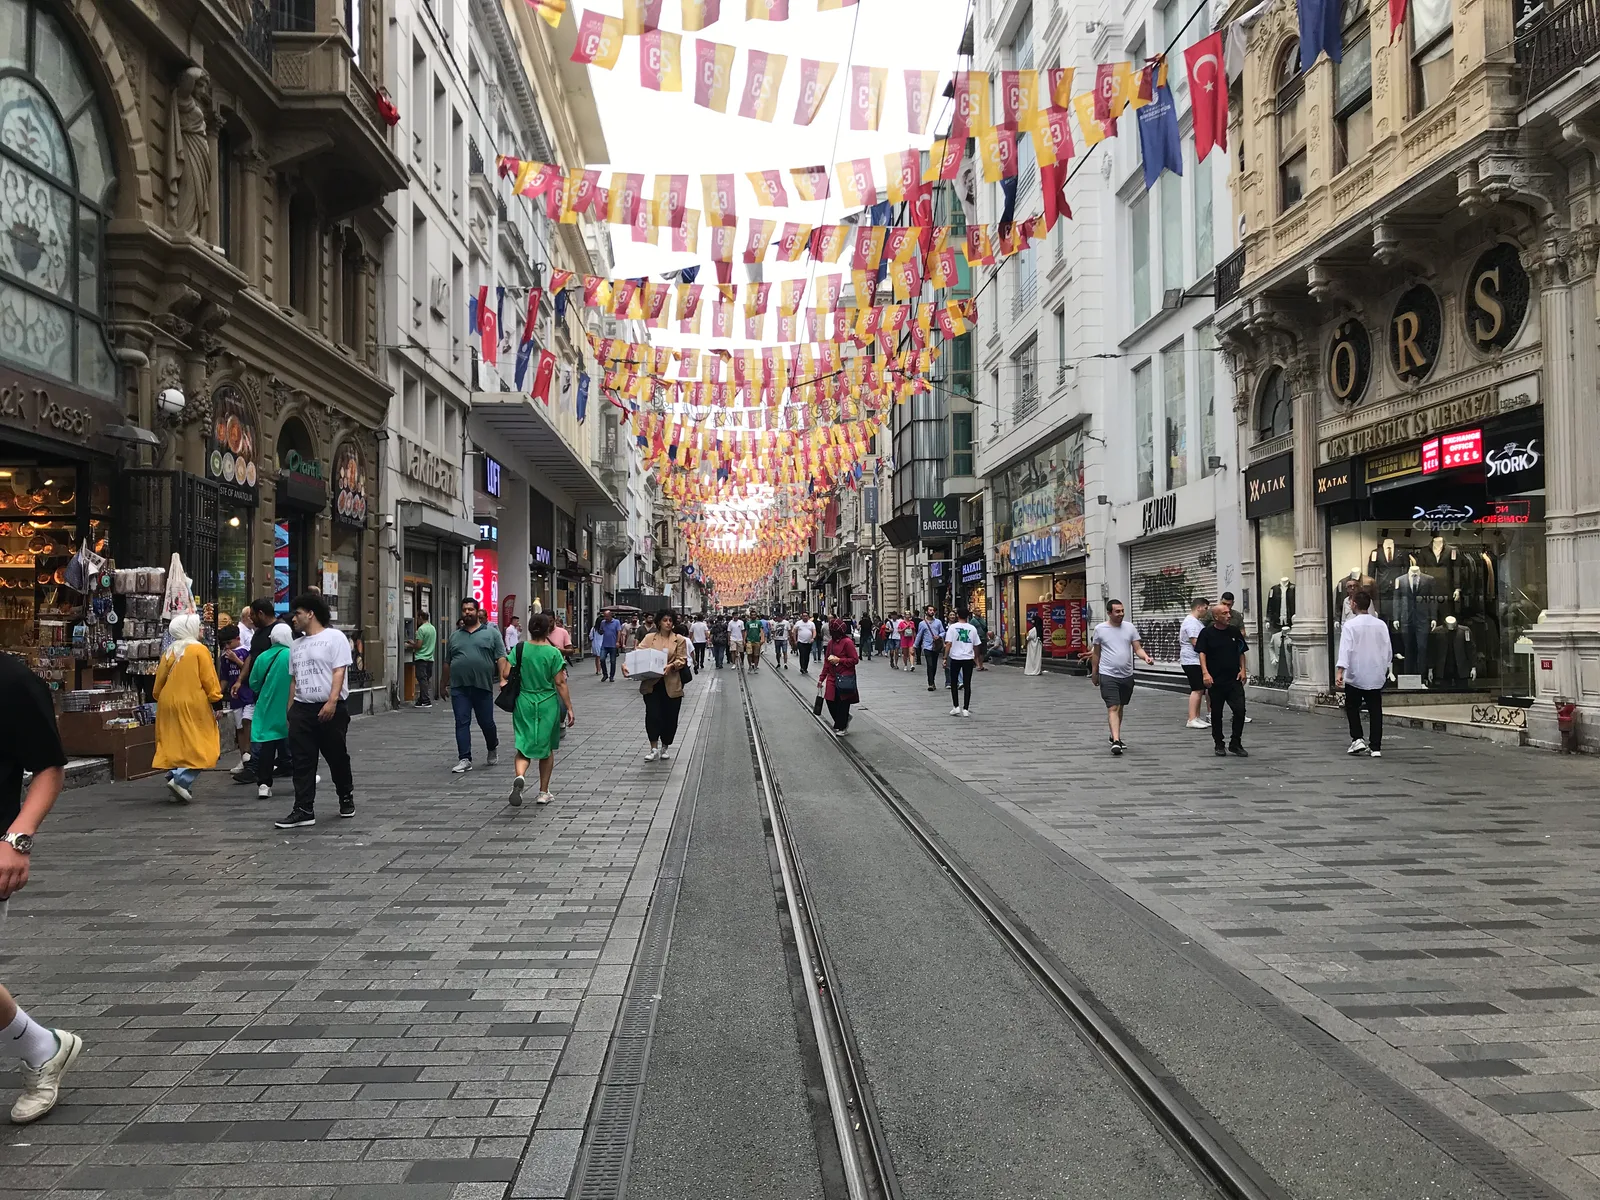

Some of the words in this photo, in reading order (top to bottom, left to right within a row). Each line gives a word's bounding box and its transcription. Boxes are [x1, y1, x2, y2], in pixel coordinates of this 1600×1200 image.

[1041, 125, 1062, 148] 23
[989, 140, 1009, 162] 23
[847, 173, 866, 191] 23
[893, 167, 912, 185] 23
[570, 179, 590, 197] 23
[758, 180, 778, 194] 23
[616, 190, 633, 208] 23
[660, 191, 678, 210] 23
[710, 191, 727, 209] 23
[936, 261, 951, 275] 23
[898, 271, 914, 286] 23
[1443, 432, 1481, 445] EXCHANGE
[1449, 441, 1474, 452] OFFICE
[1369, 456, 1398, 469] WESTERN
[1485, 439, 1538, 478] STORKS
[1377, 464, 1398, 474] UNION
[922, 520, 958, 530] BARGELLO
[301, 668, 323, 676] LONELY
